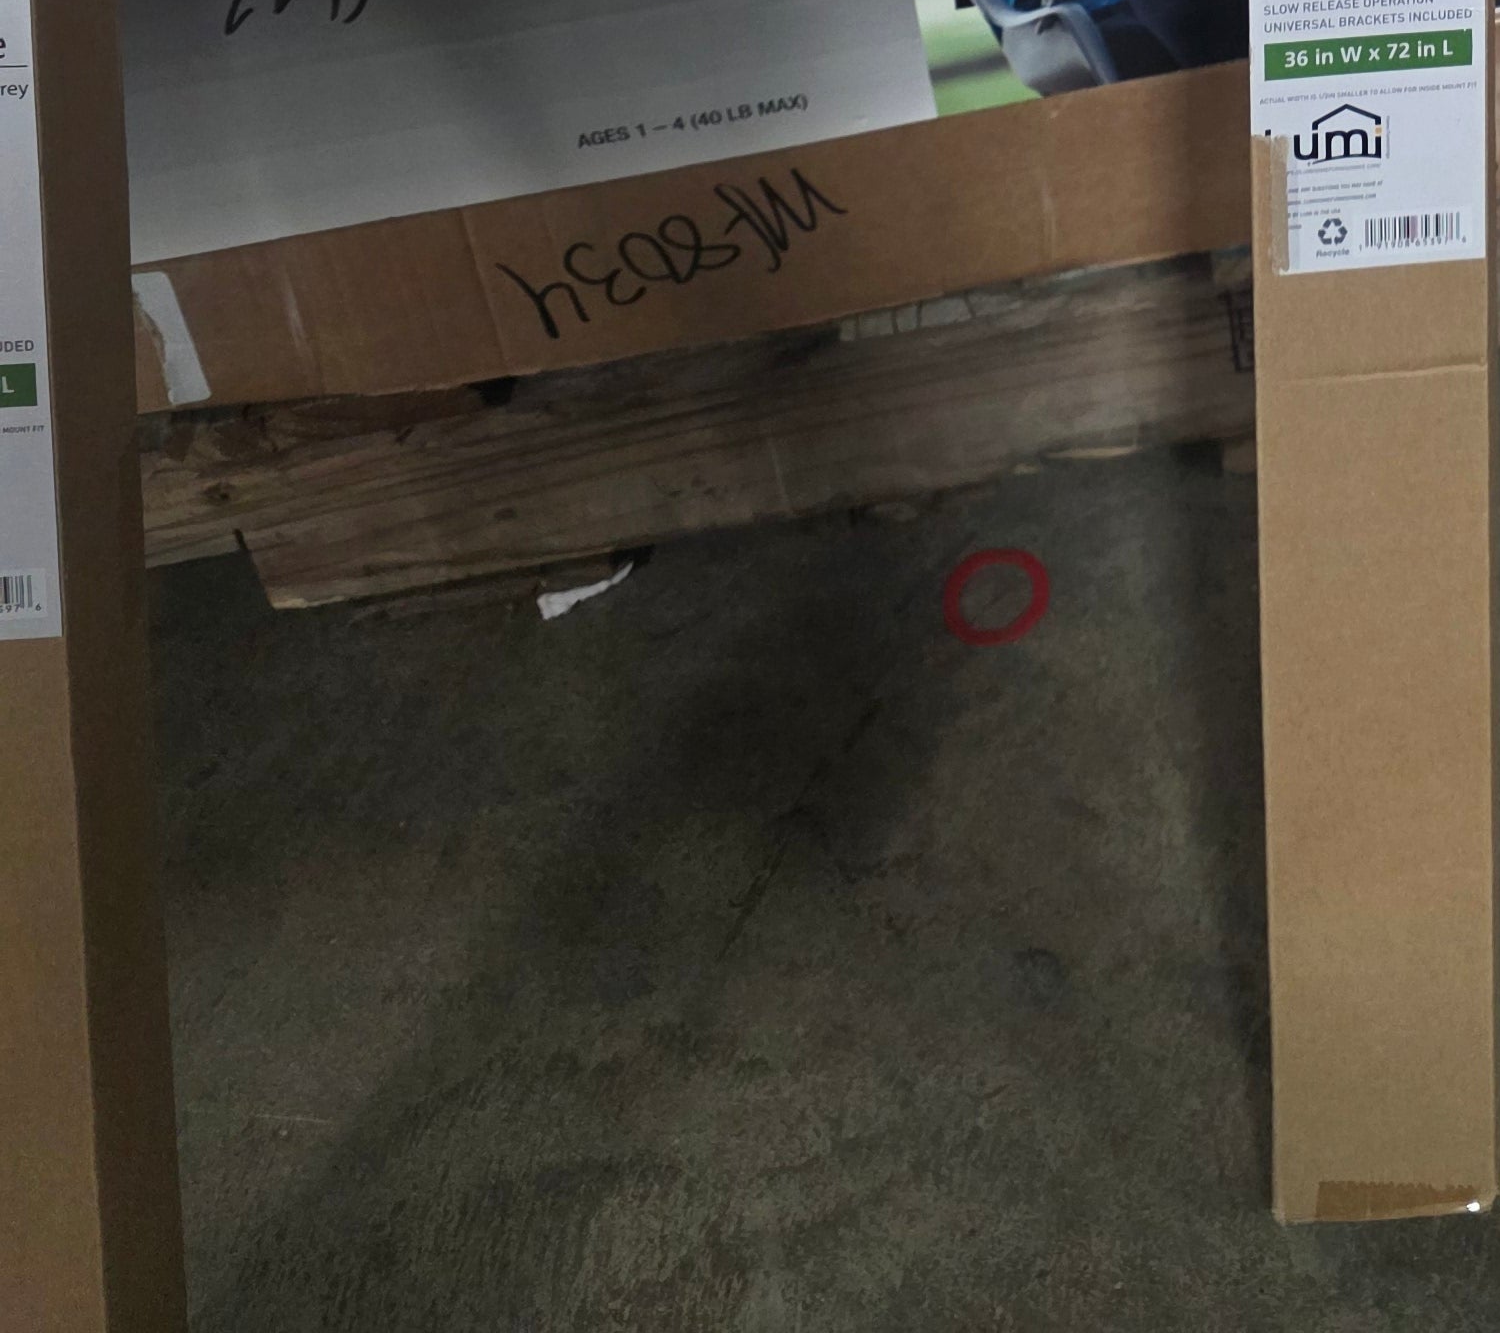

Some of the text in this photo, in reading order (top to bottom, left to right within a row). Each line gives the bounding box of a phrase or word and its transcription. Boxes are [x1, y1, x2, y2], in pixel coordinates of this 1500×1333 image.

[1263, 2, 1300, 16] SLOW
[1263, 8, 1472, 34] UNIVERSAL BRACKETS INCLUDED
[1284, 39, 1454, 69] 36 in W x 72 in L
[578, 126, 631, 149] AGES
[636, 124, 647, 137] 1
[673, 116, 685, 131] 4
[727, 104, 752, 122] LB
[757, 93, 808, 116] MAX)
[1316, 249, 1350, 258] Recycle
